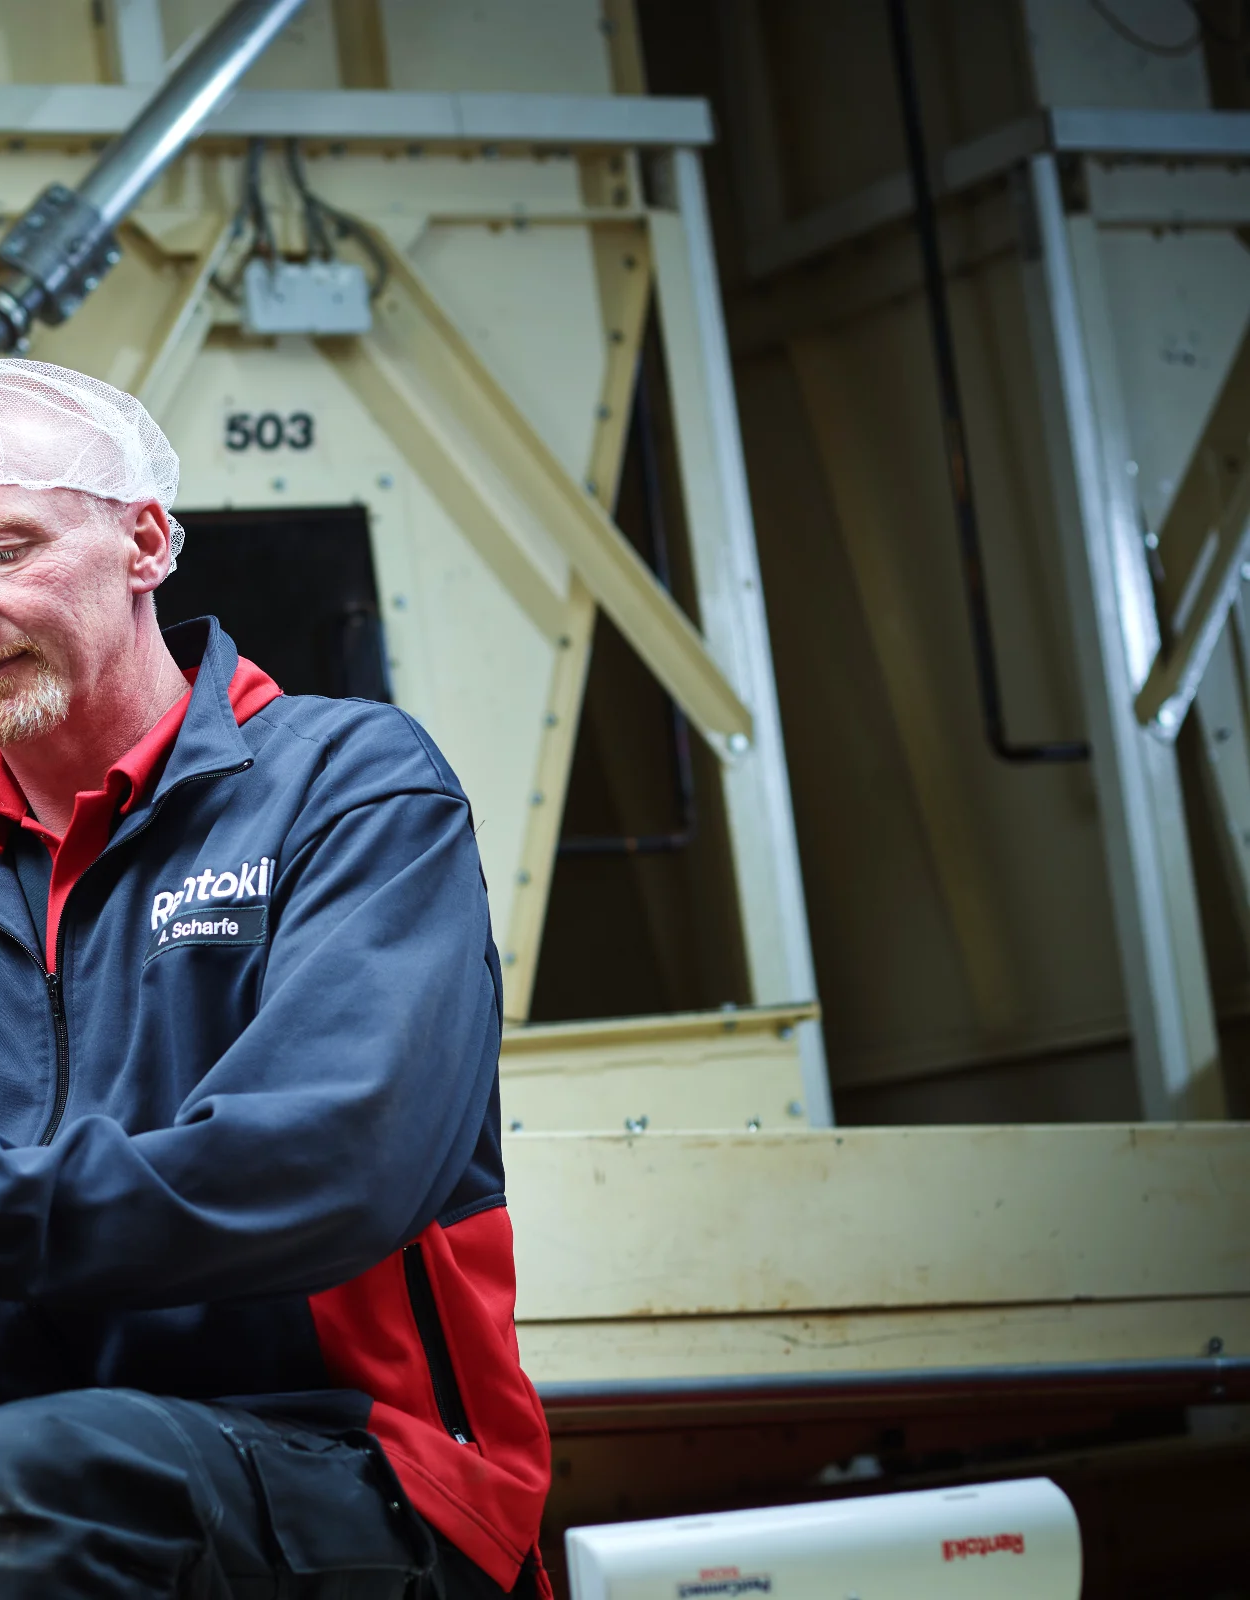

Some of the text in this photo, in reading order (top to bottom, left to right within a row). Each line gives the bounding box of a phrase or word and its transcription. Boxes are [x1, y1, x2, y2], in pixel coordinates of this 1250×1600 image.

[224, 412, 313, 452] 503
[171, 917, 239, 939] Scharfe
[942, 1532, 1024, 1561] Rentokil
